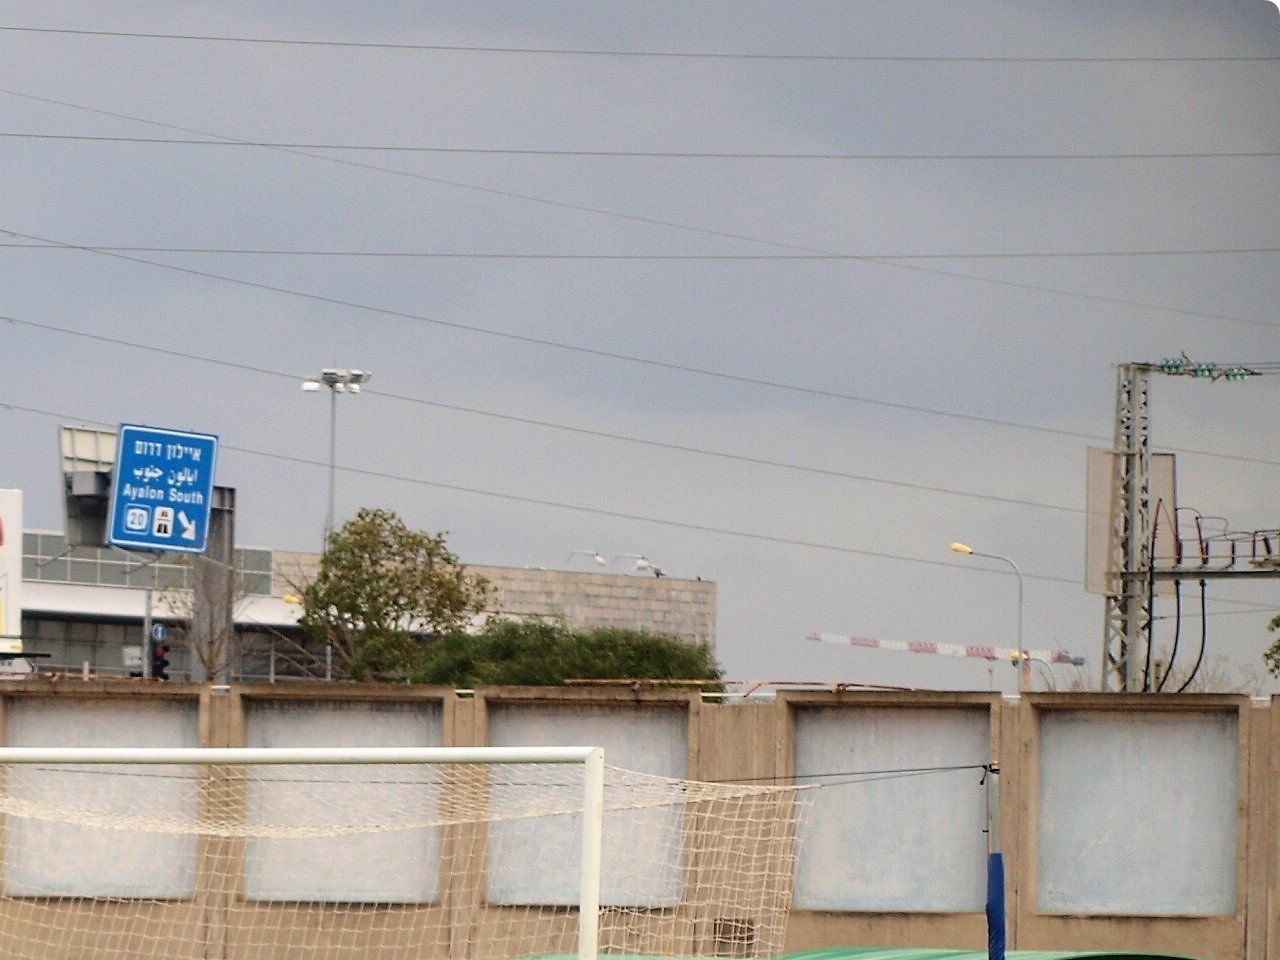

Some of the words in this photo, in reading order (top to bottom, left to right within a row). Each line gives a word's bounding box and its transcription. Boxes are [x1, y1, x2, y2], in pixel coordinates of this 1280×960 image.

[134, 440, 162, 457] דרום
[166, 443, 202, 462] איילון
[133, 464, 164, 482] جنوب
[123, 483, 164, 501] Ayalon
[169, 488, 204, 505] South
[130, 512, 144, 525] 20
